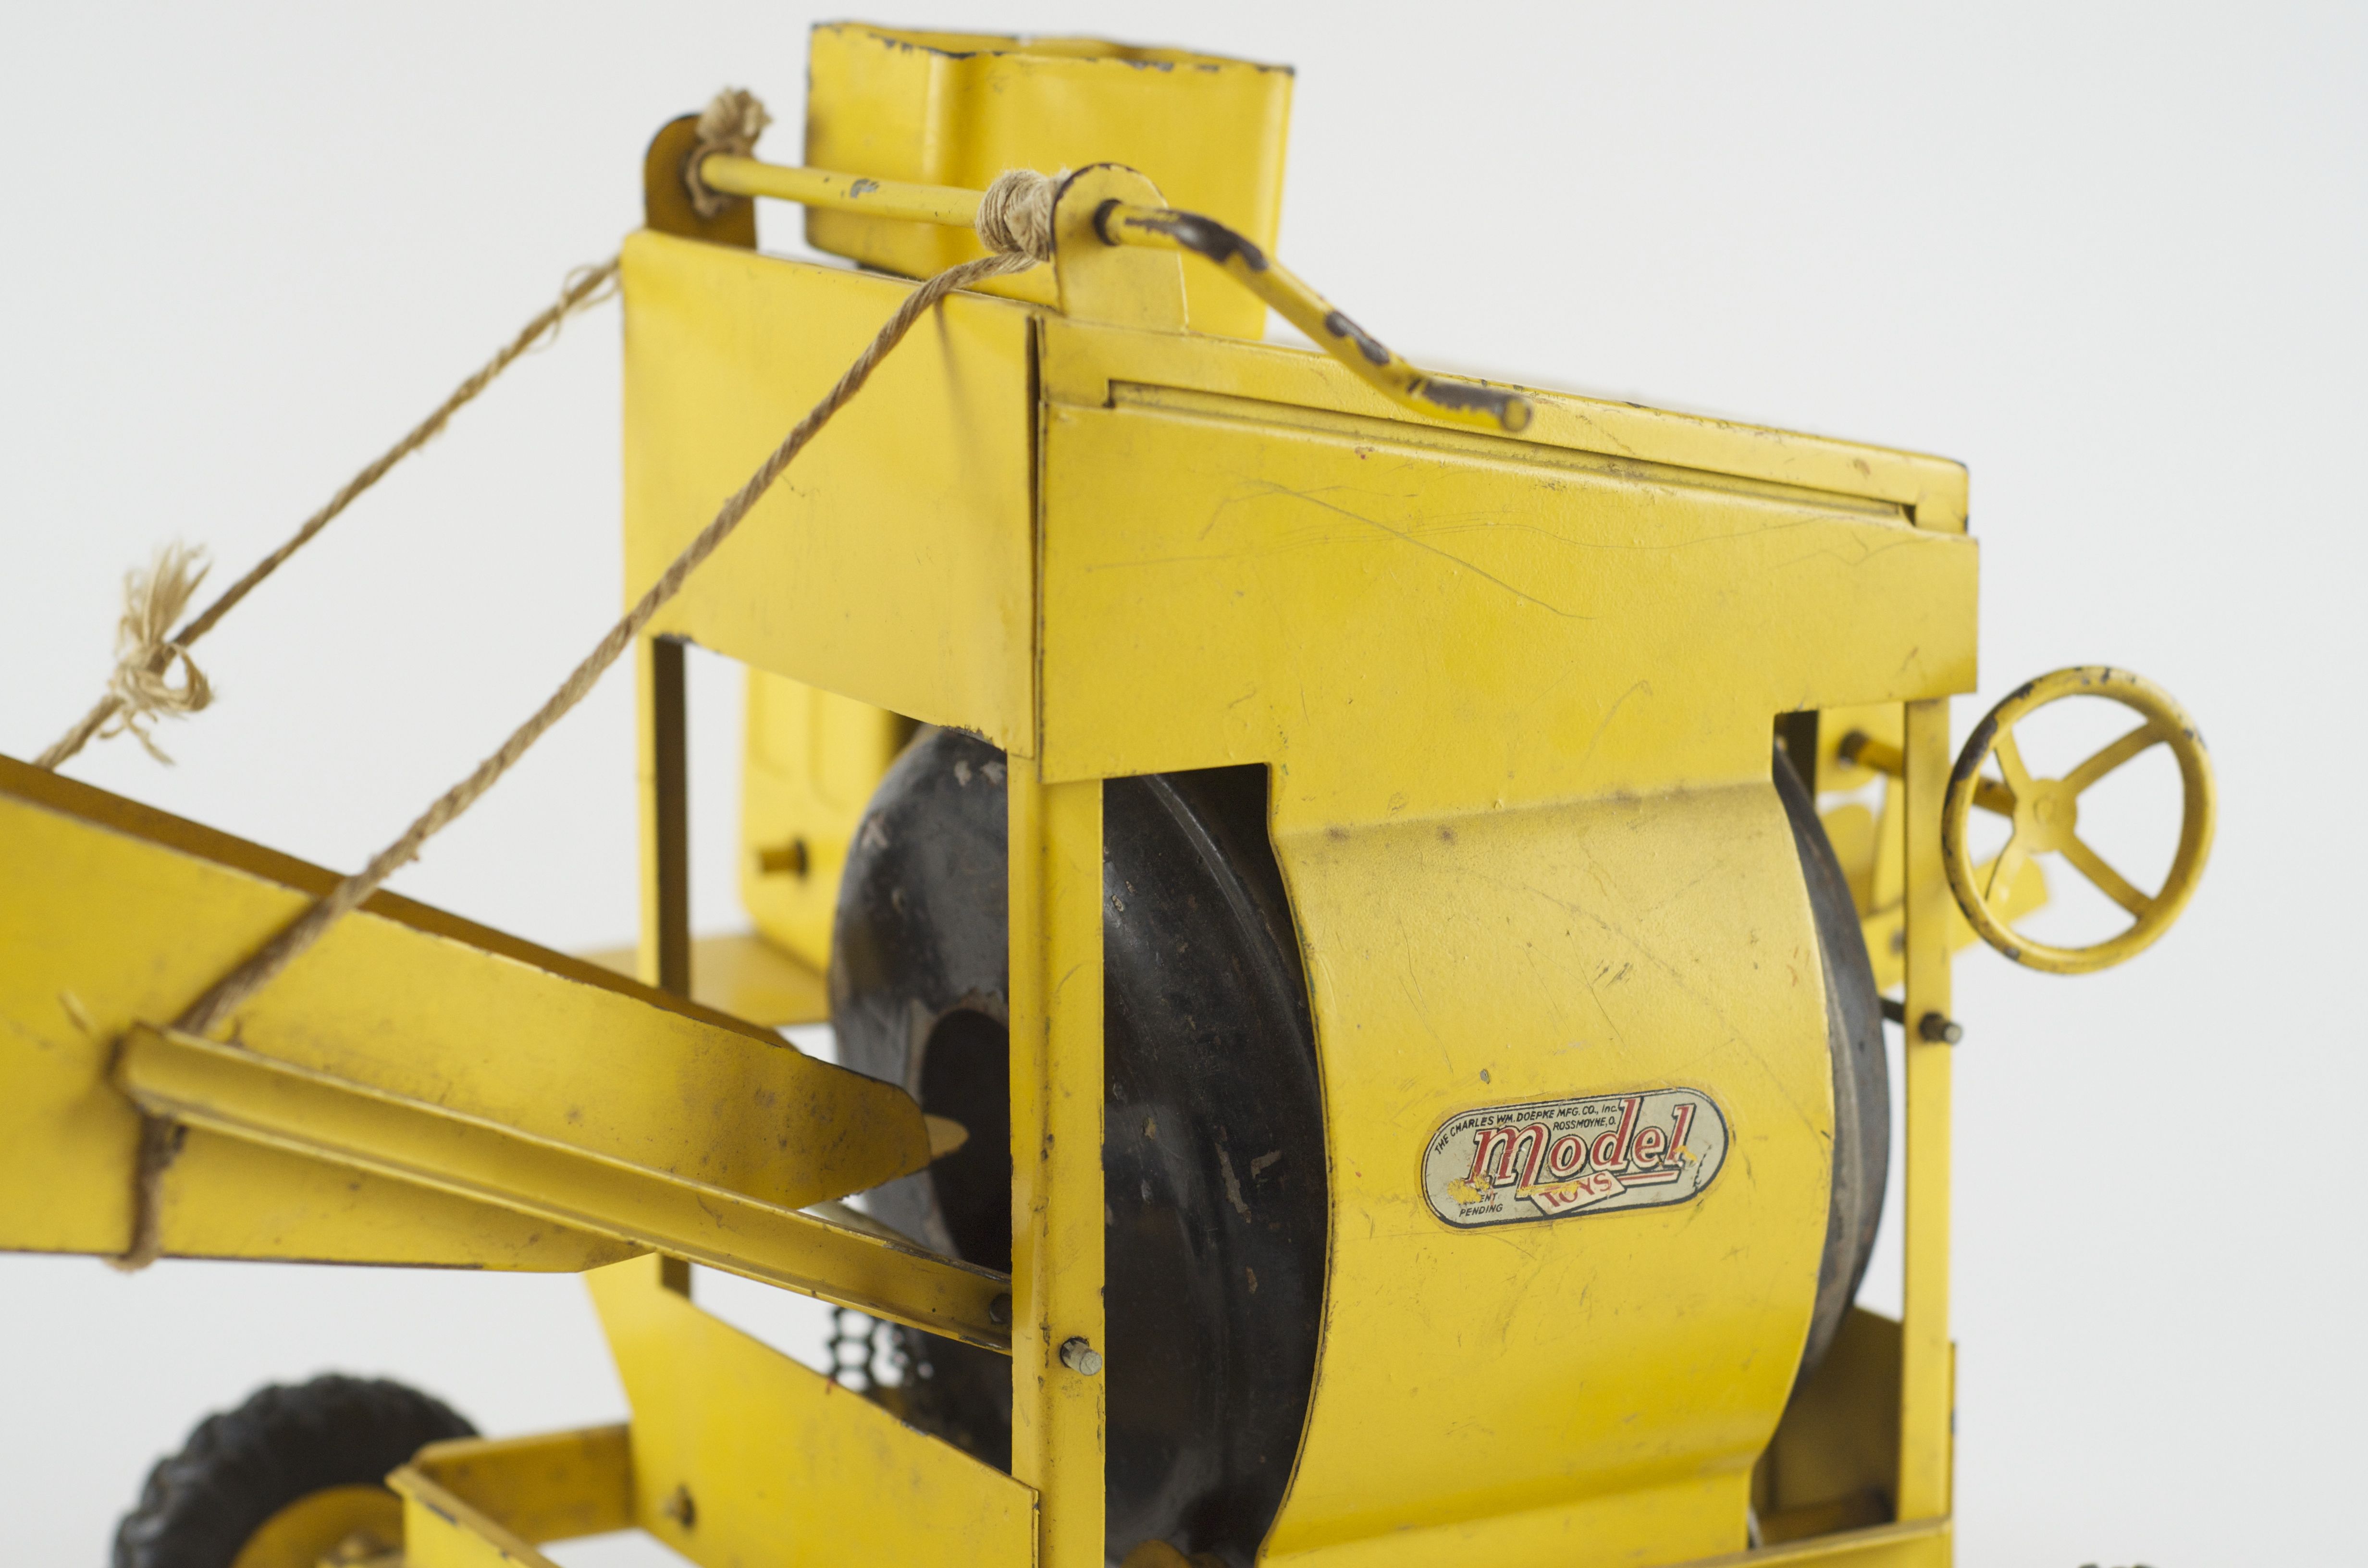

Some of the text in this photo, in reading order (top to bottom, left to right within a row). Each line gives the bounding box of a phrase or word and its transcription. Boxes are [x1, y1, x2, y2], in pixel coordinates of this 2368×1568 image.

[1434, 1133, 1449, 1155] THE
[1450, 1115, 1494, 1137] CHARLES
[1516, 1109, 1555, 1121] DOEPKE
[1556, 1107, 1580, 1118] MFG.
[1602, 1104, 1617, 1113] Inc.
[1553, 1117, 1607, 1131] ROSSMOYNE,
[1539, 1173, 1613, 1208] TOYS
[1459, 1203, 1503, 1217] PENDING
